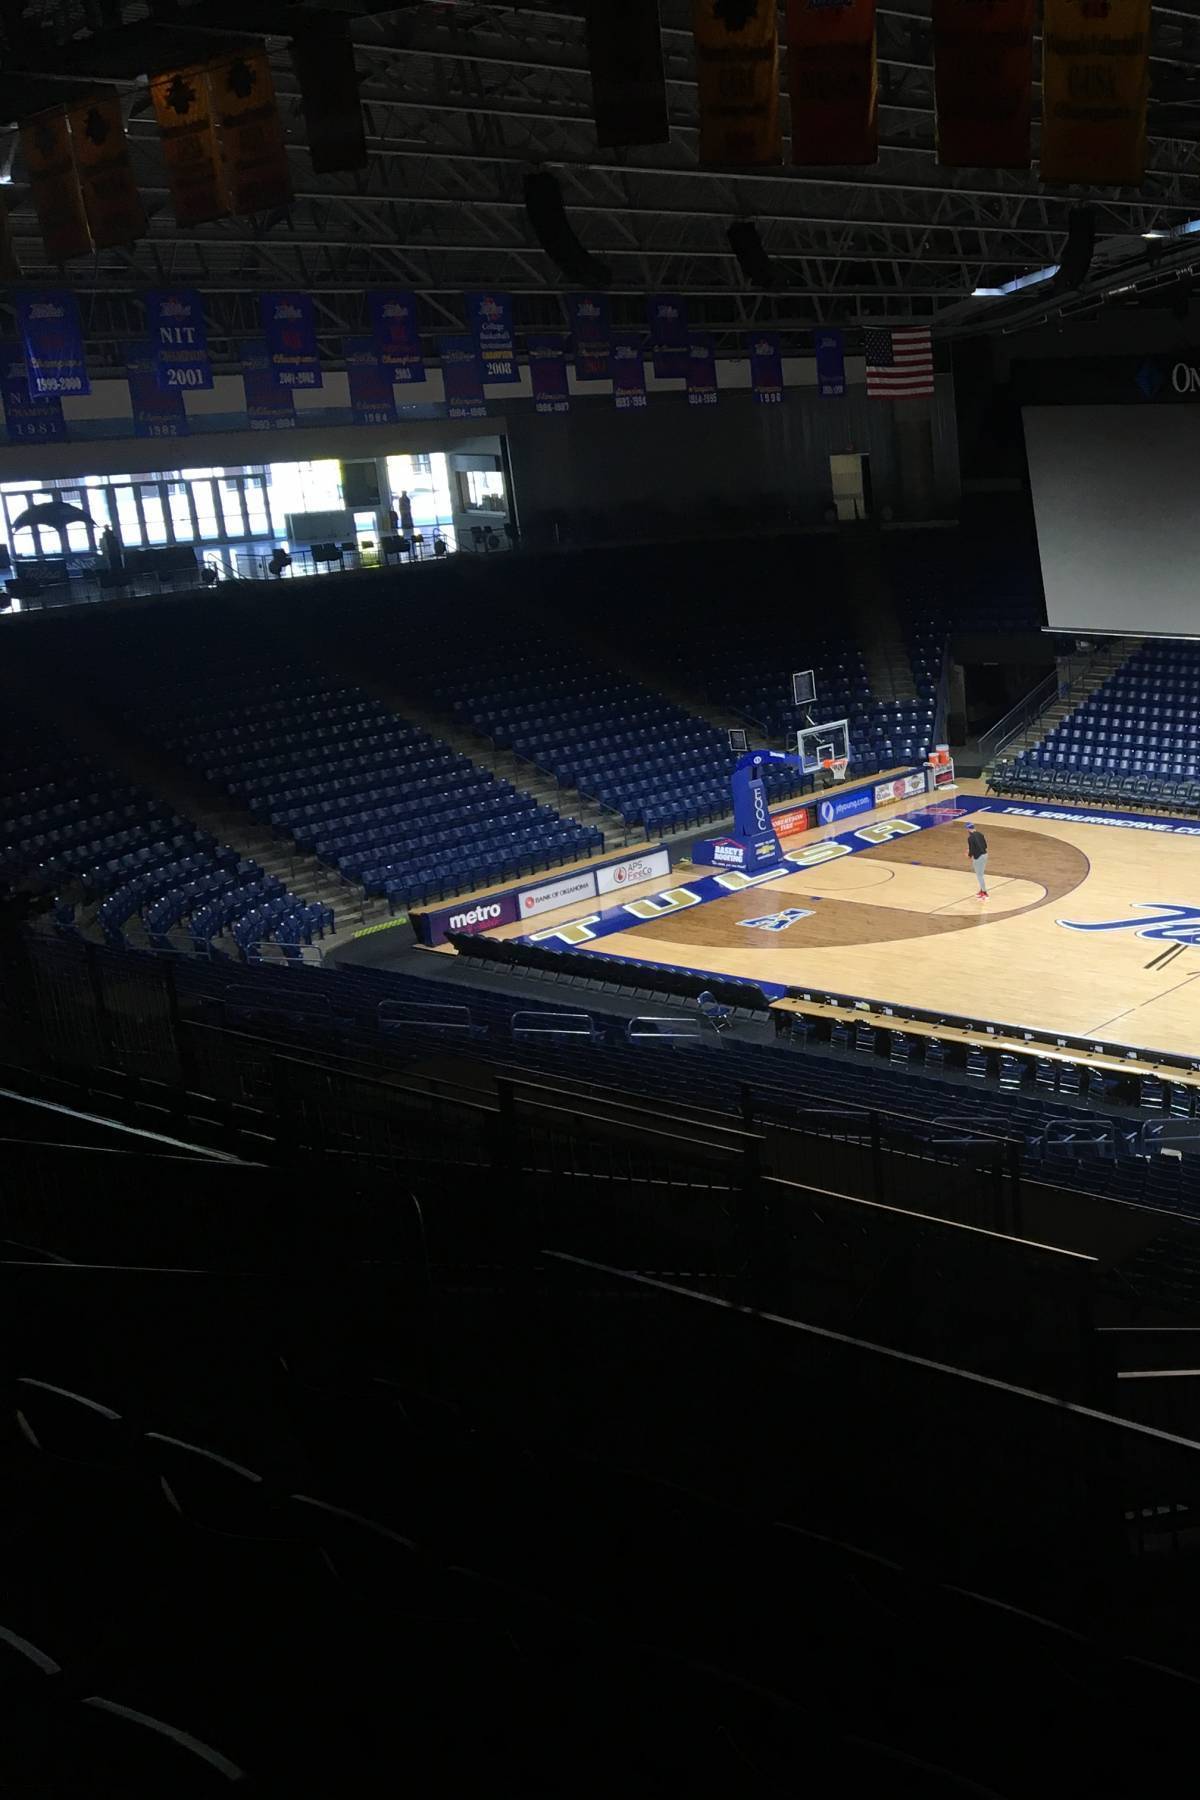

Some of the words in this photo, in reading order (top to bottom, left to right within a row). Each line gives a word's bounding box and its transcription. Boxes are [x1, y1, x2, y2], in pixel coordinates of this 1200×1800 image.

[160, 327, 195, 344] NIT
[167, 368, 203, 385] 2001
[15, 423, 57, 435] 1981
[628, 861, 643, 872] APS
[529, 818, 922, 946] TULSA
[449, 903, 502, 929] metro
